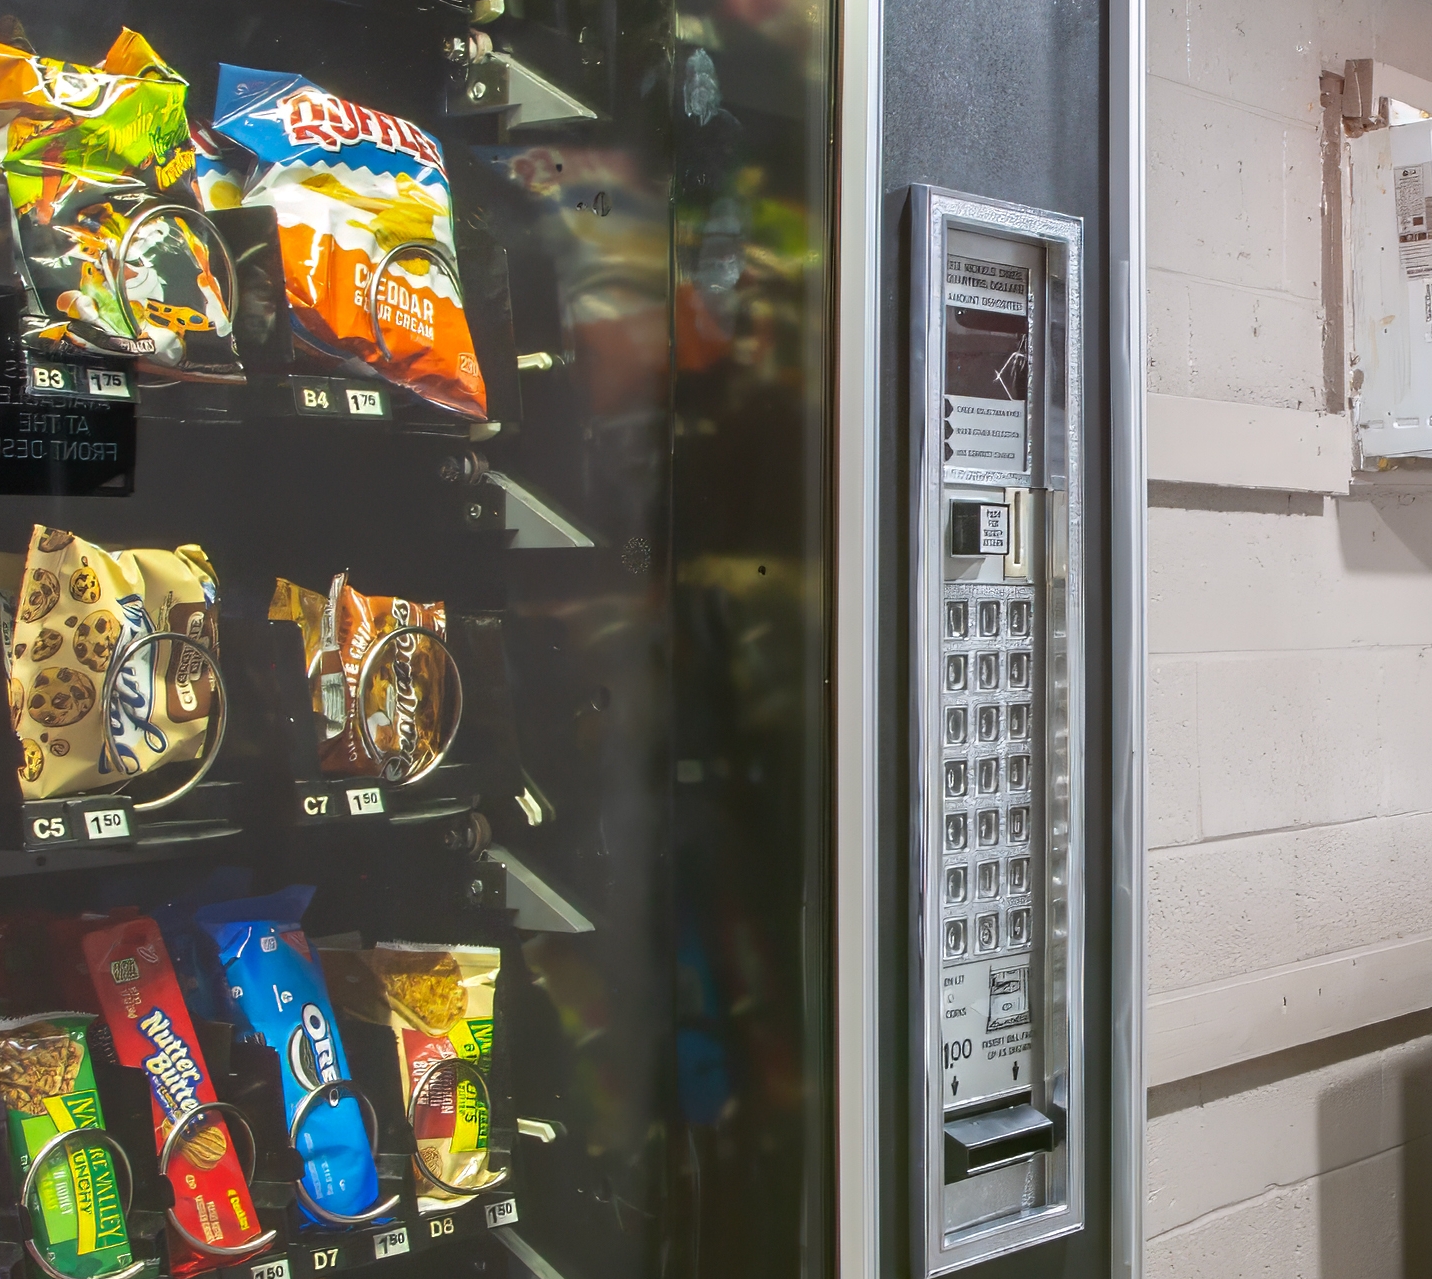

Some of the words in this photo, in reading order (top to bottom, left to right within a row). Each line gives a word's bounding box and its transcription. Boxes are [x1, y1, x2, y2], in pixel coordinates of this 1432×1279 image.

[277, 87, 447, 161] RUFFLE
[354, 262, 435, 324] CEDDAR
[33, 367, 65, 389] B3
[90, 374, 122, 392] 175
[303, 389, 330, 410] B4
[350, 393, 377, 414] 175
[303, 796, 329, 815] C7
[353, 789, 379, 810] 150
[33, 818, 65, 839] C5
[90, 813, 122, 836] 150
[139, 1009, 201, 1082] Nutter
[94, 1170, 124, 1248] VALLEY
[430, 1218, 456, 1237] D8
[487, 1201, 513, 1222] 150
[314, 1247, 340, 1270] D7
